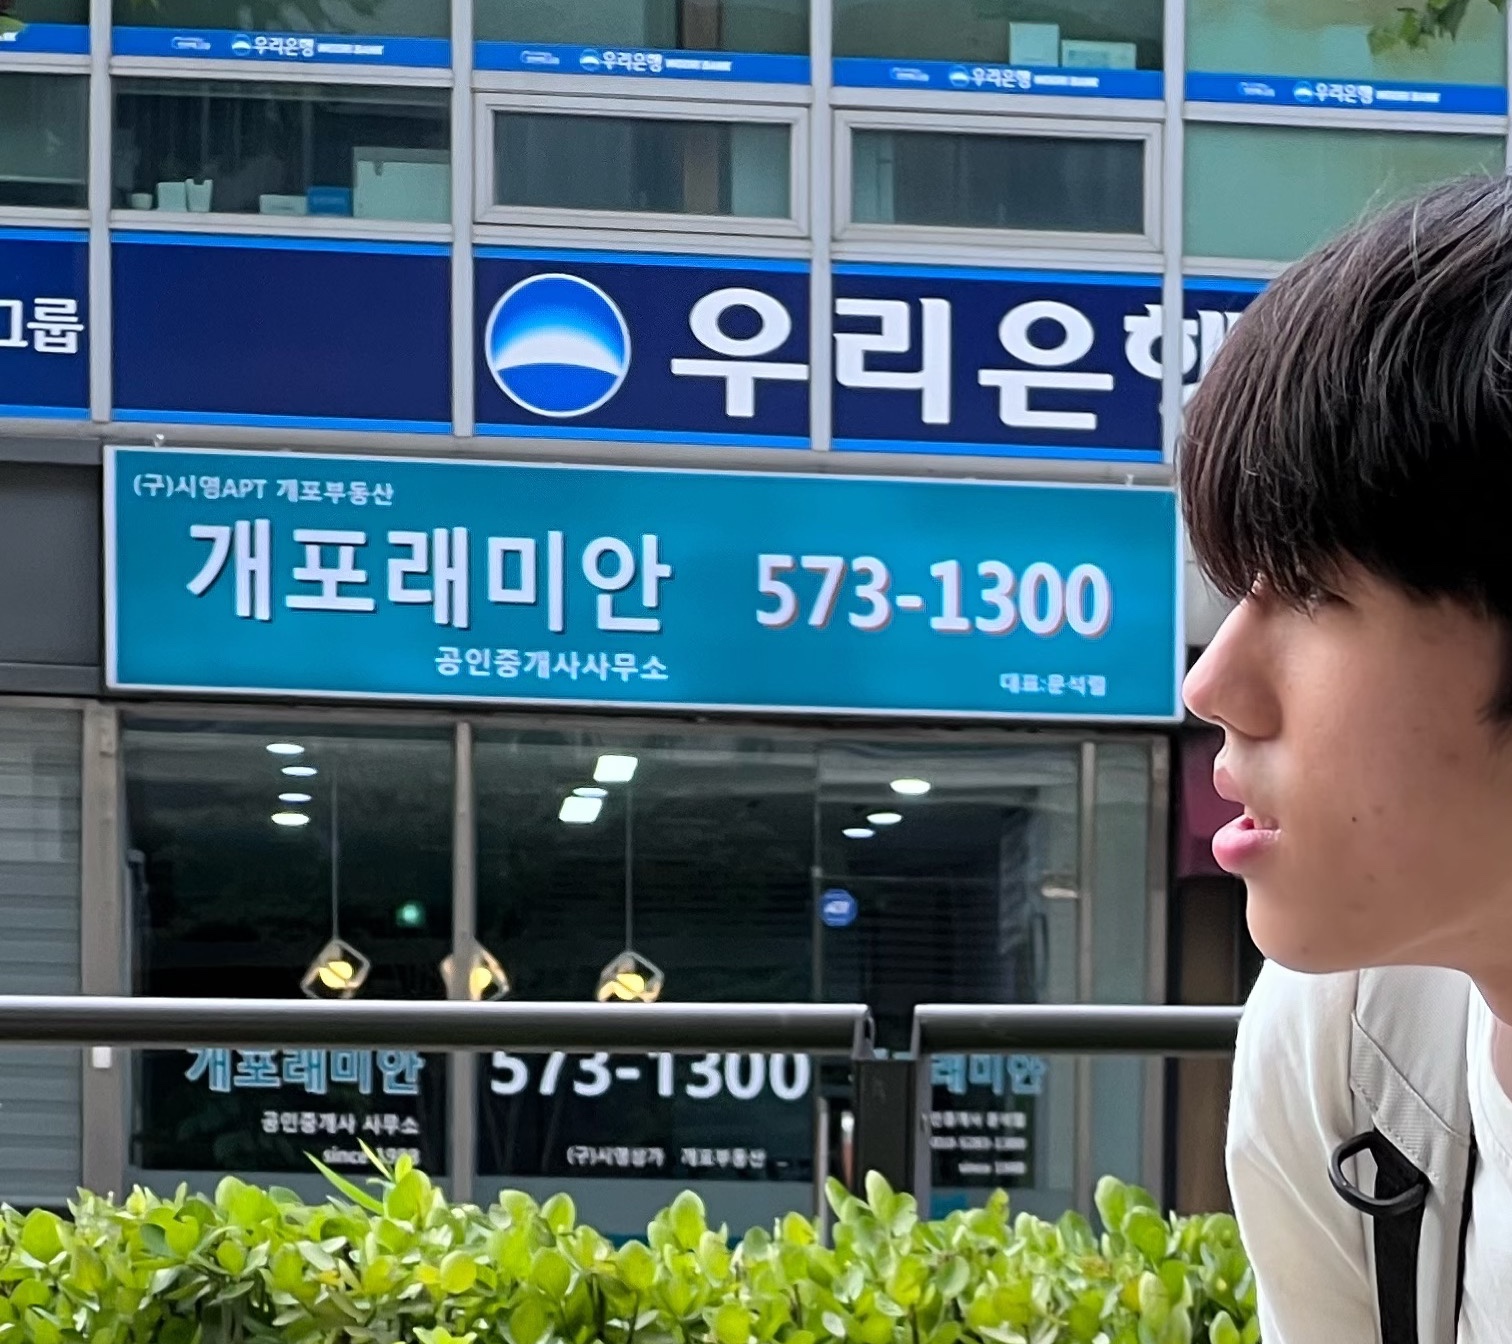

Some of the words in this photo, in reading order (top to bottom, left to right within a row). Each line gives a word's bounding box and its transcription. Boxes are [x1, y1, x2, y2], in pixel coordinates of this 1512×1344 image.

[276, 479, 394, 507] 개포부동산
[186, 519, 672, 633] 개포래미안
[756, 554, 1113, 637] 573-1300
[185, 1048, 426, 1094] 개포래미안
[490, 1051, 811, 1100] 573-1300
